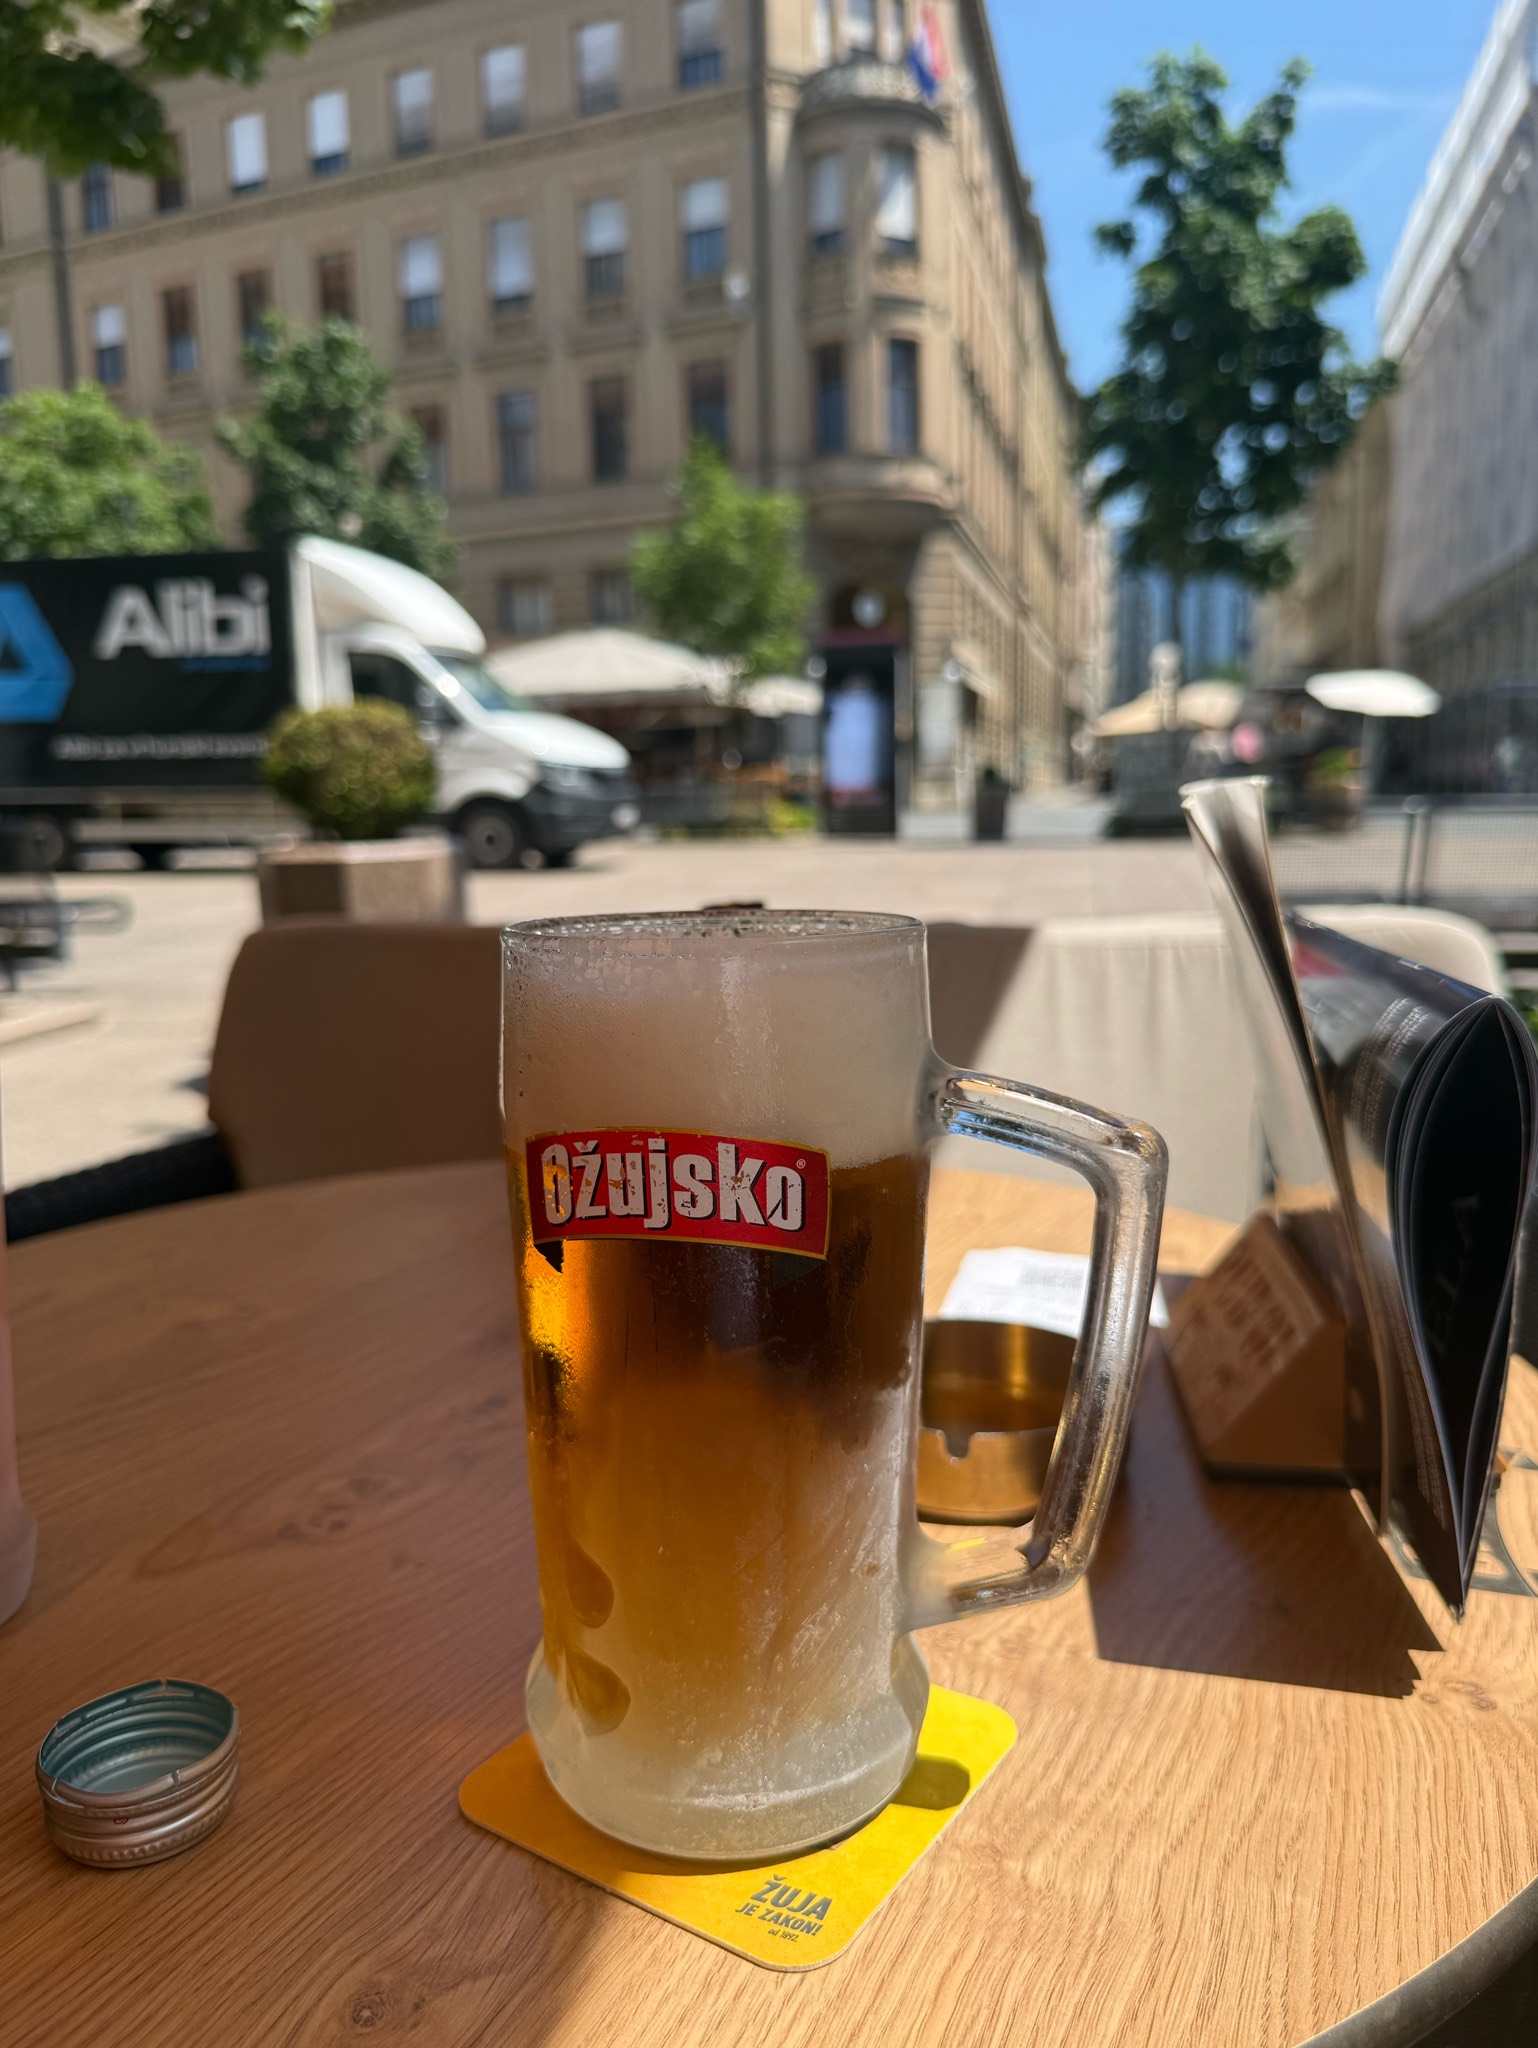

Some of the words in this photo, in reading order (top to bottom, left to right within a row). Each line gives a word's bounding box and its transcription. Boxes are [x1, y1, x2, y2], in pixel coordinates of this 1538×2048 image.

[95, 576, 270, 659] Alibi
[542, 1138, 804, 1230] Ožujsko
[735, 1903, 760, 1916] JE
[758, 1908, 824, 1937] ZAKON!
[750, 1874, 833, 1921] ŽUJA
